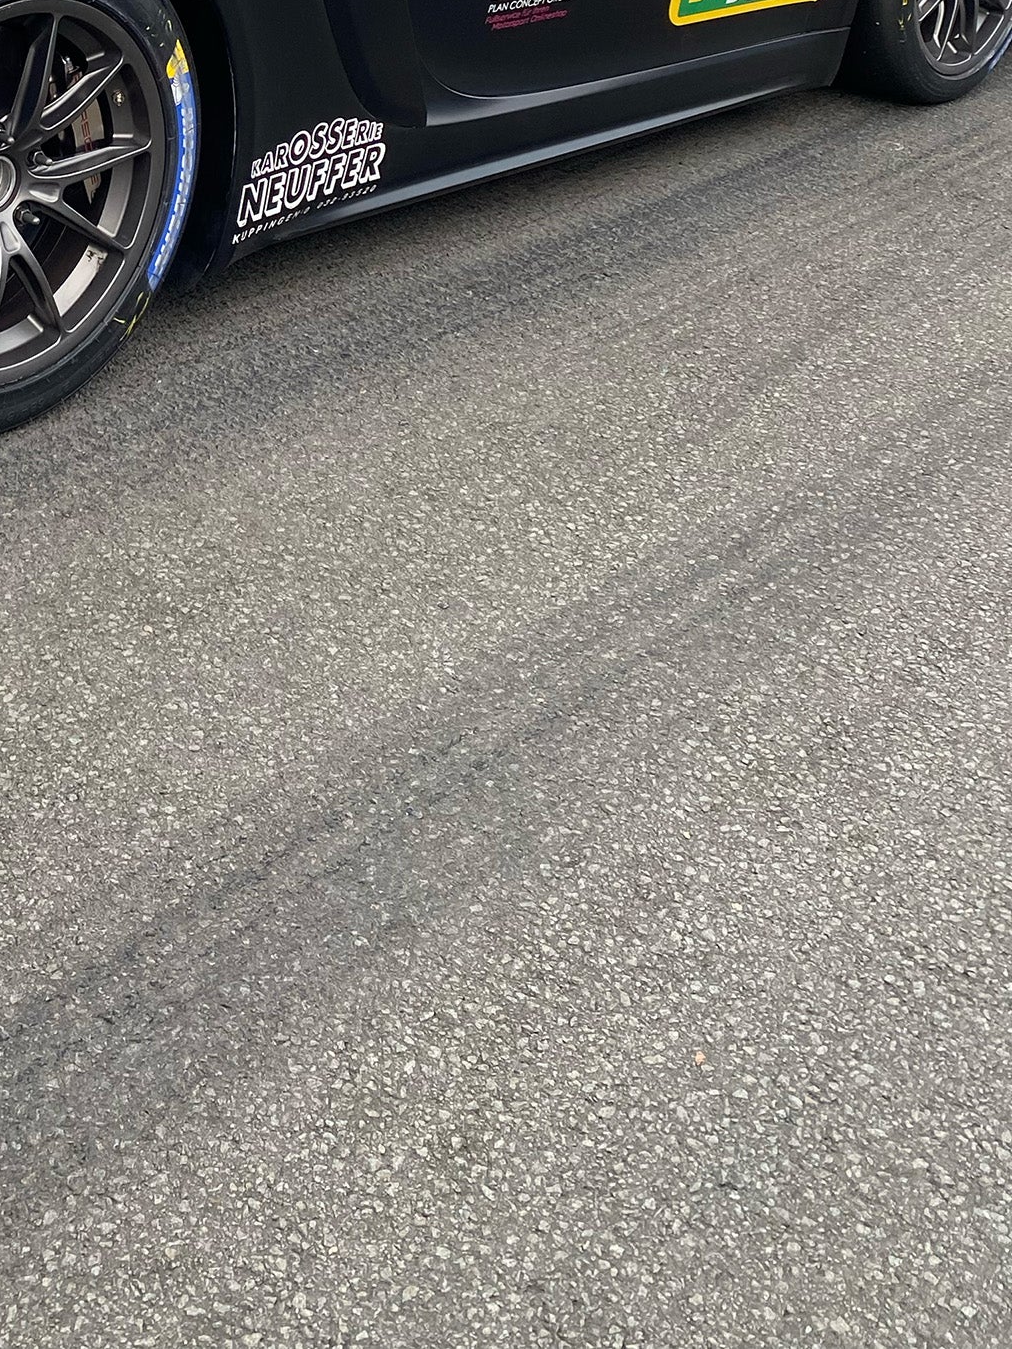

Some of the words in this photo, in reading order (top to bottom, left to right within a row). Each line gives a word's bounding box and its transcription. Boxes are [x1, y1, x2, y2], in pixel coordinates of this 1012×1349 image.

[487, 1, 509, 13] PLAN
[250, 117, 384, 179] KAROSSERIE
[236, 142, 387, 228] NEUFFER
